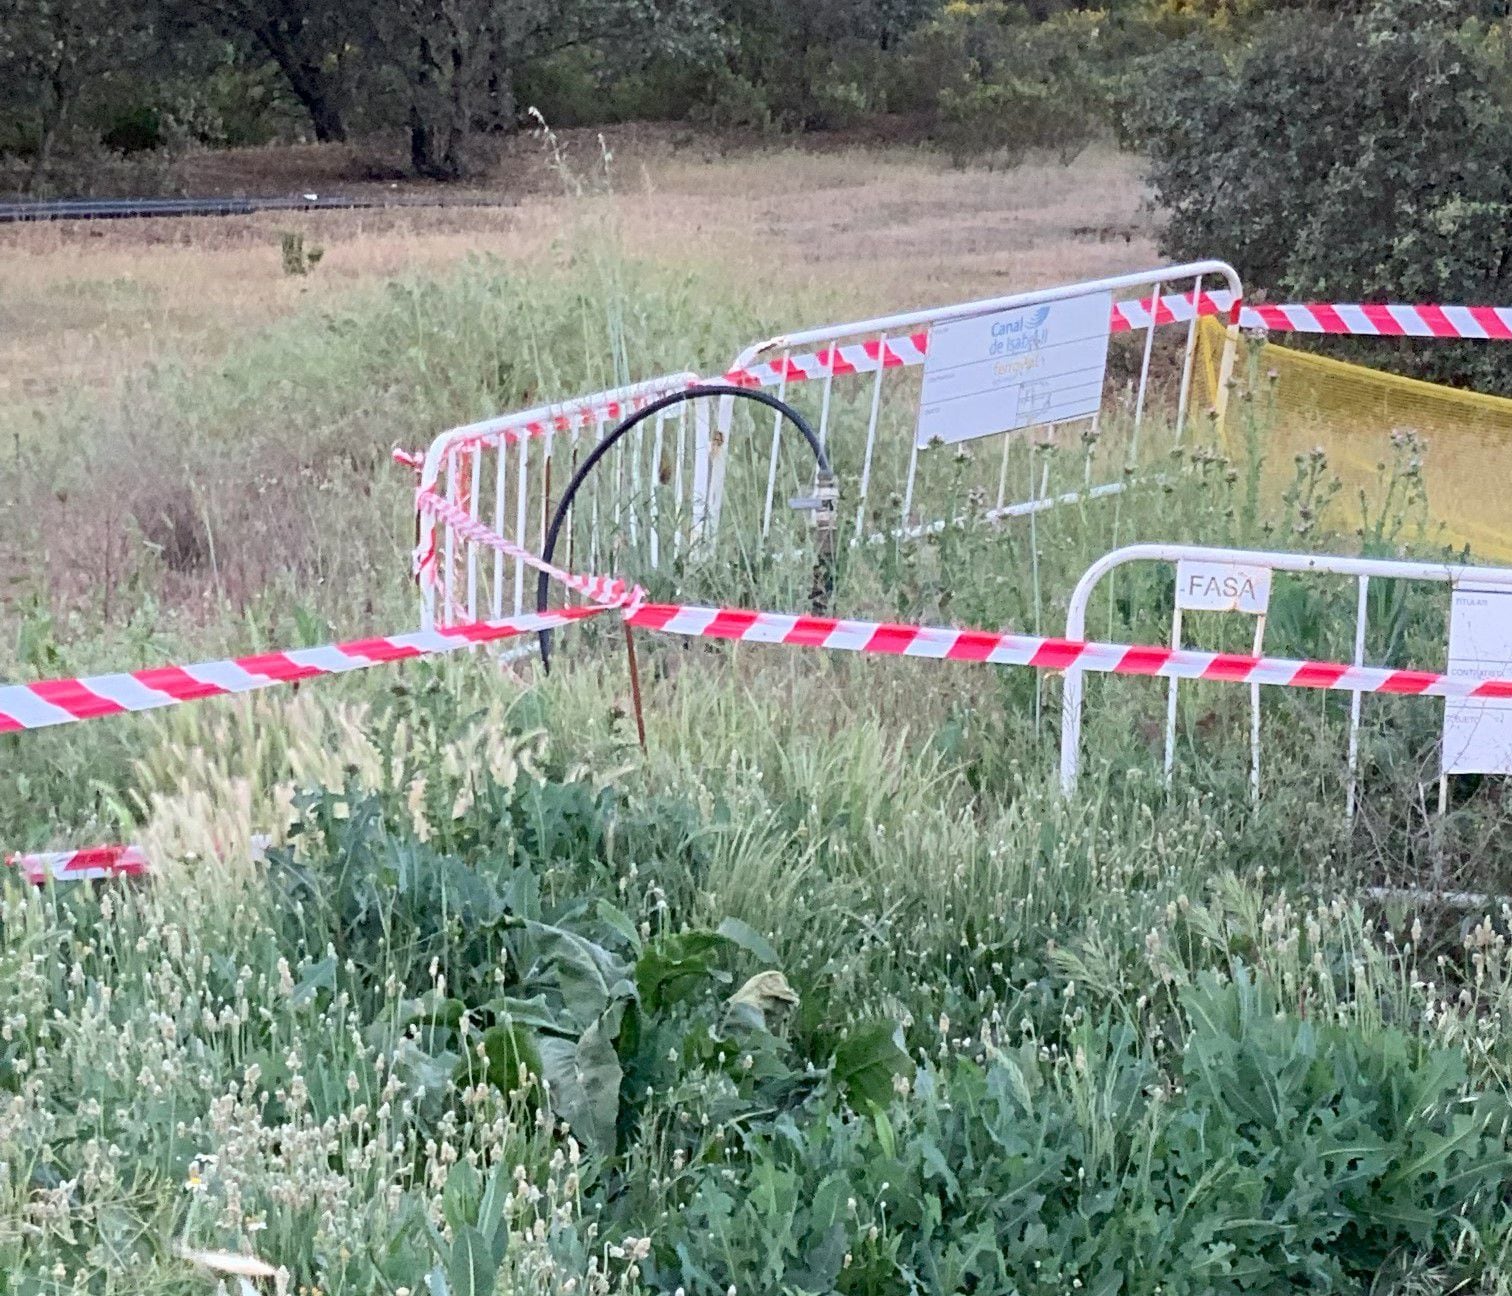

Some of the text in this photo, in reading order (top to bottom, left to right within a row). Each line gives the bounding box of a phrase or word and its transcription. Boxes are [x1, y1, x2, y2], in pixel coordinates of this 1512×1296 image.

[991, 316, 1024, 337] Canal
[989, 339, 1004, 355] de
[1189, 574, 1256, 600] FASA
